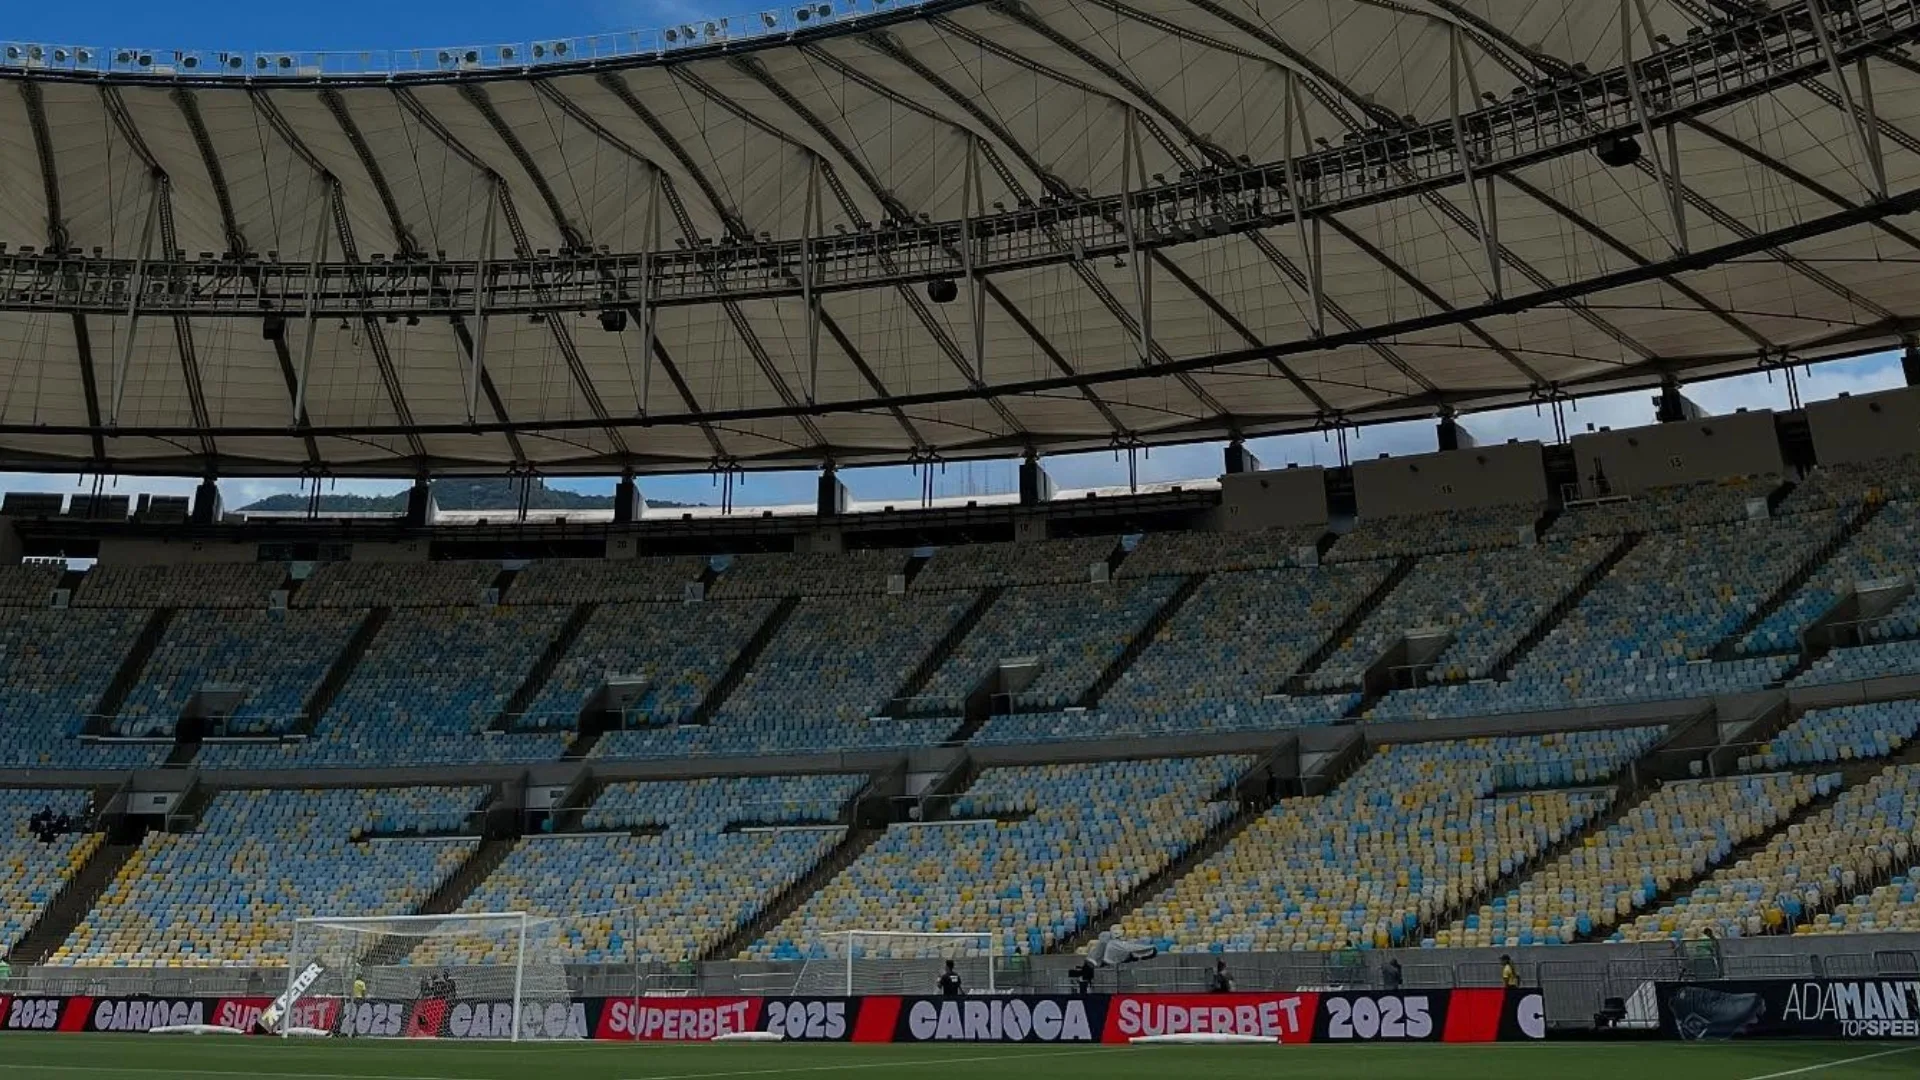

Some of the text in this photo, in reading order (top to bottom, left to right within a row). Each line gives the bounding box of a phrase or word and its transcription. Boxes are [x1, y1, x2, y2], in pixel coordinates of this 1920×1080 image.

[8, 999, 59, 1029] 2025
[94, 999, 204, 1031] CARIOCA
[220, 1001, 331, 1033] SUPBET
[340, 1002, 403, 1034] 2025
[609, 1001, 749, 1040] SUPERBET
[767, 1001, 847, 1039] 2025
[909, 999, 1092, 1040] CARIOCA
[1118, 997, 1301, 1036] SUPERBET
[1326, 995, 1433, 1038] 2025
